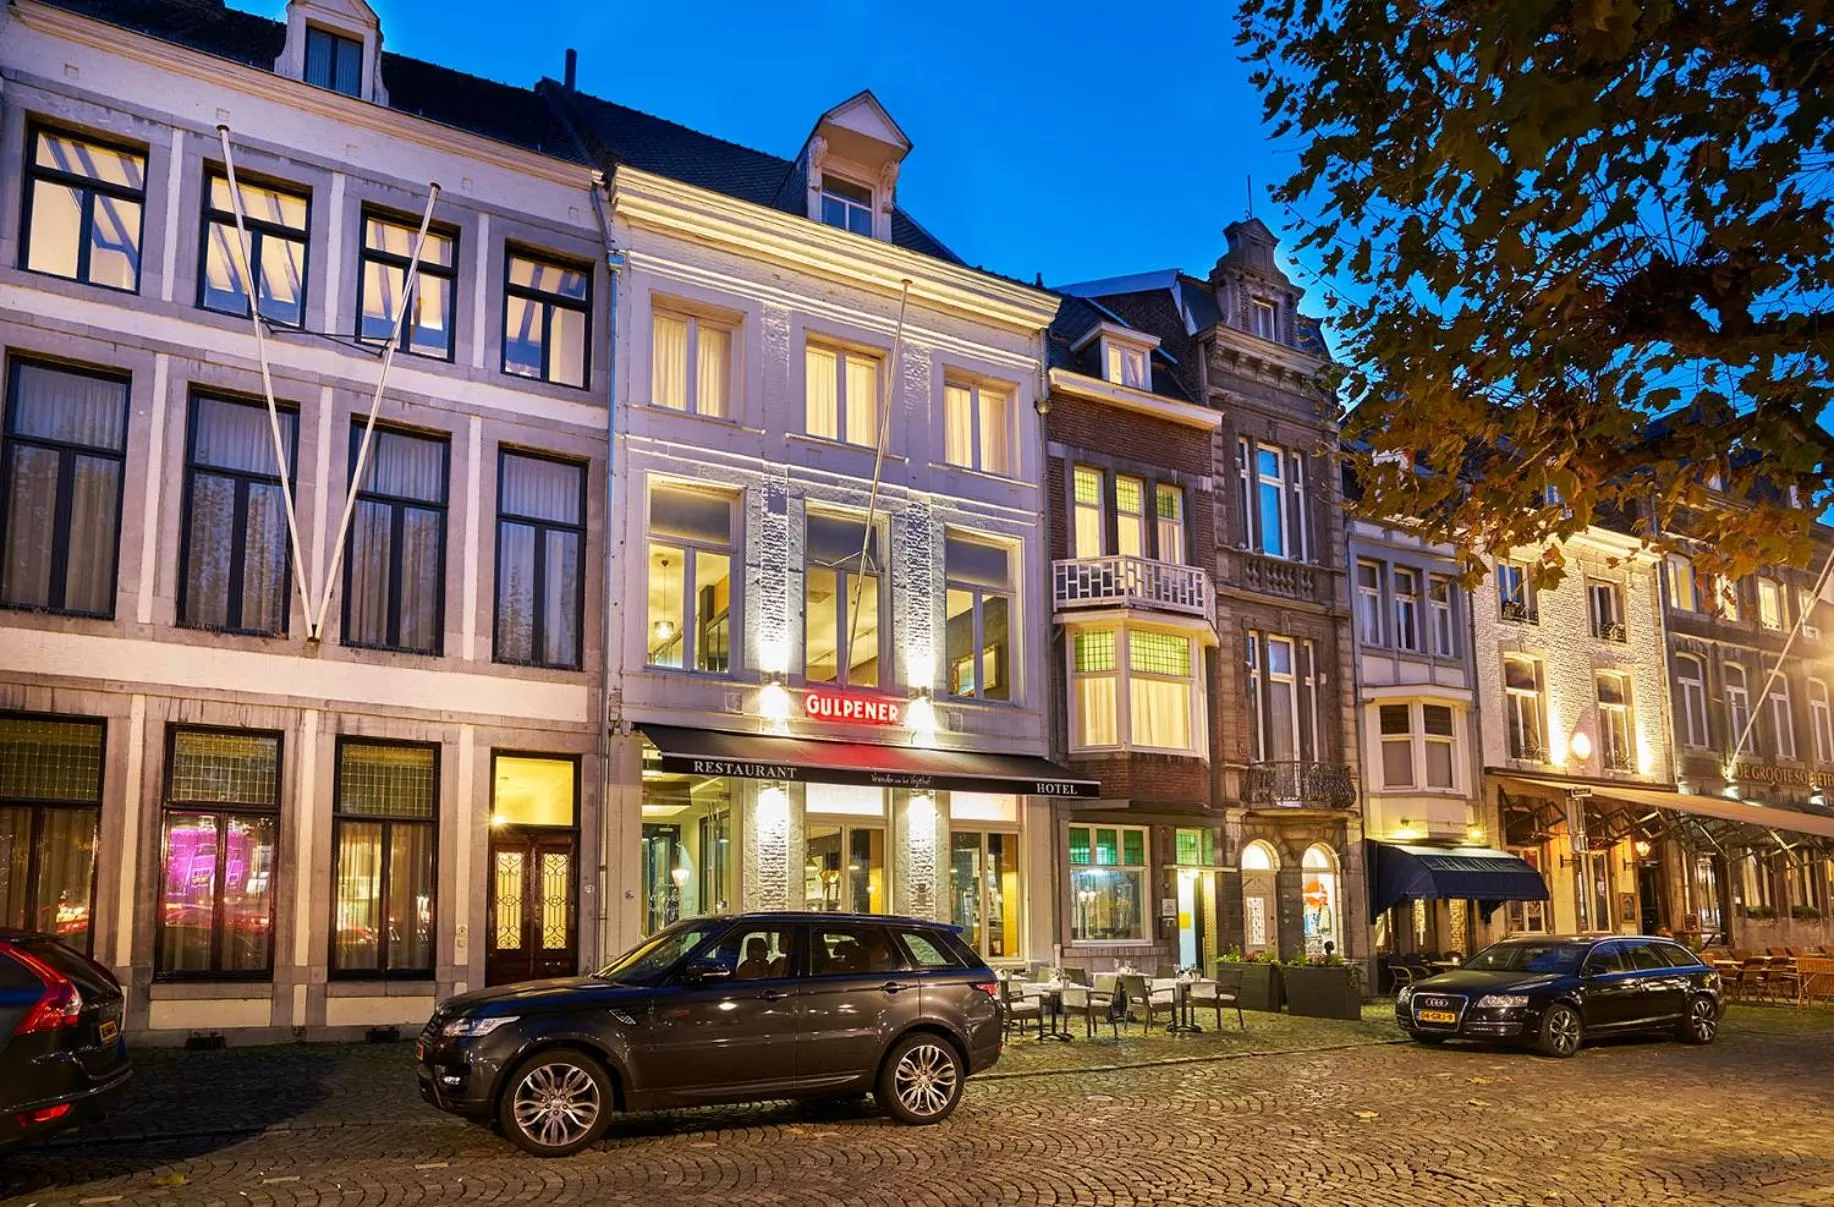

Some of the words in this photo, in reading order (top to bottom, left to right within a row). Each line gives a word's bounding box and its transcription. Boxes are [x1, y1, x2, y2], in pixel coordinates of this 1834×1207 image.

[806, 694, 898, 722] GULPENER
[693, 760, 797, 779] RESTAURANT
[1036, 783, 1078, 795] HOTEL
